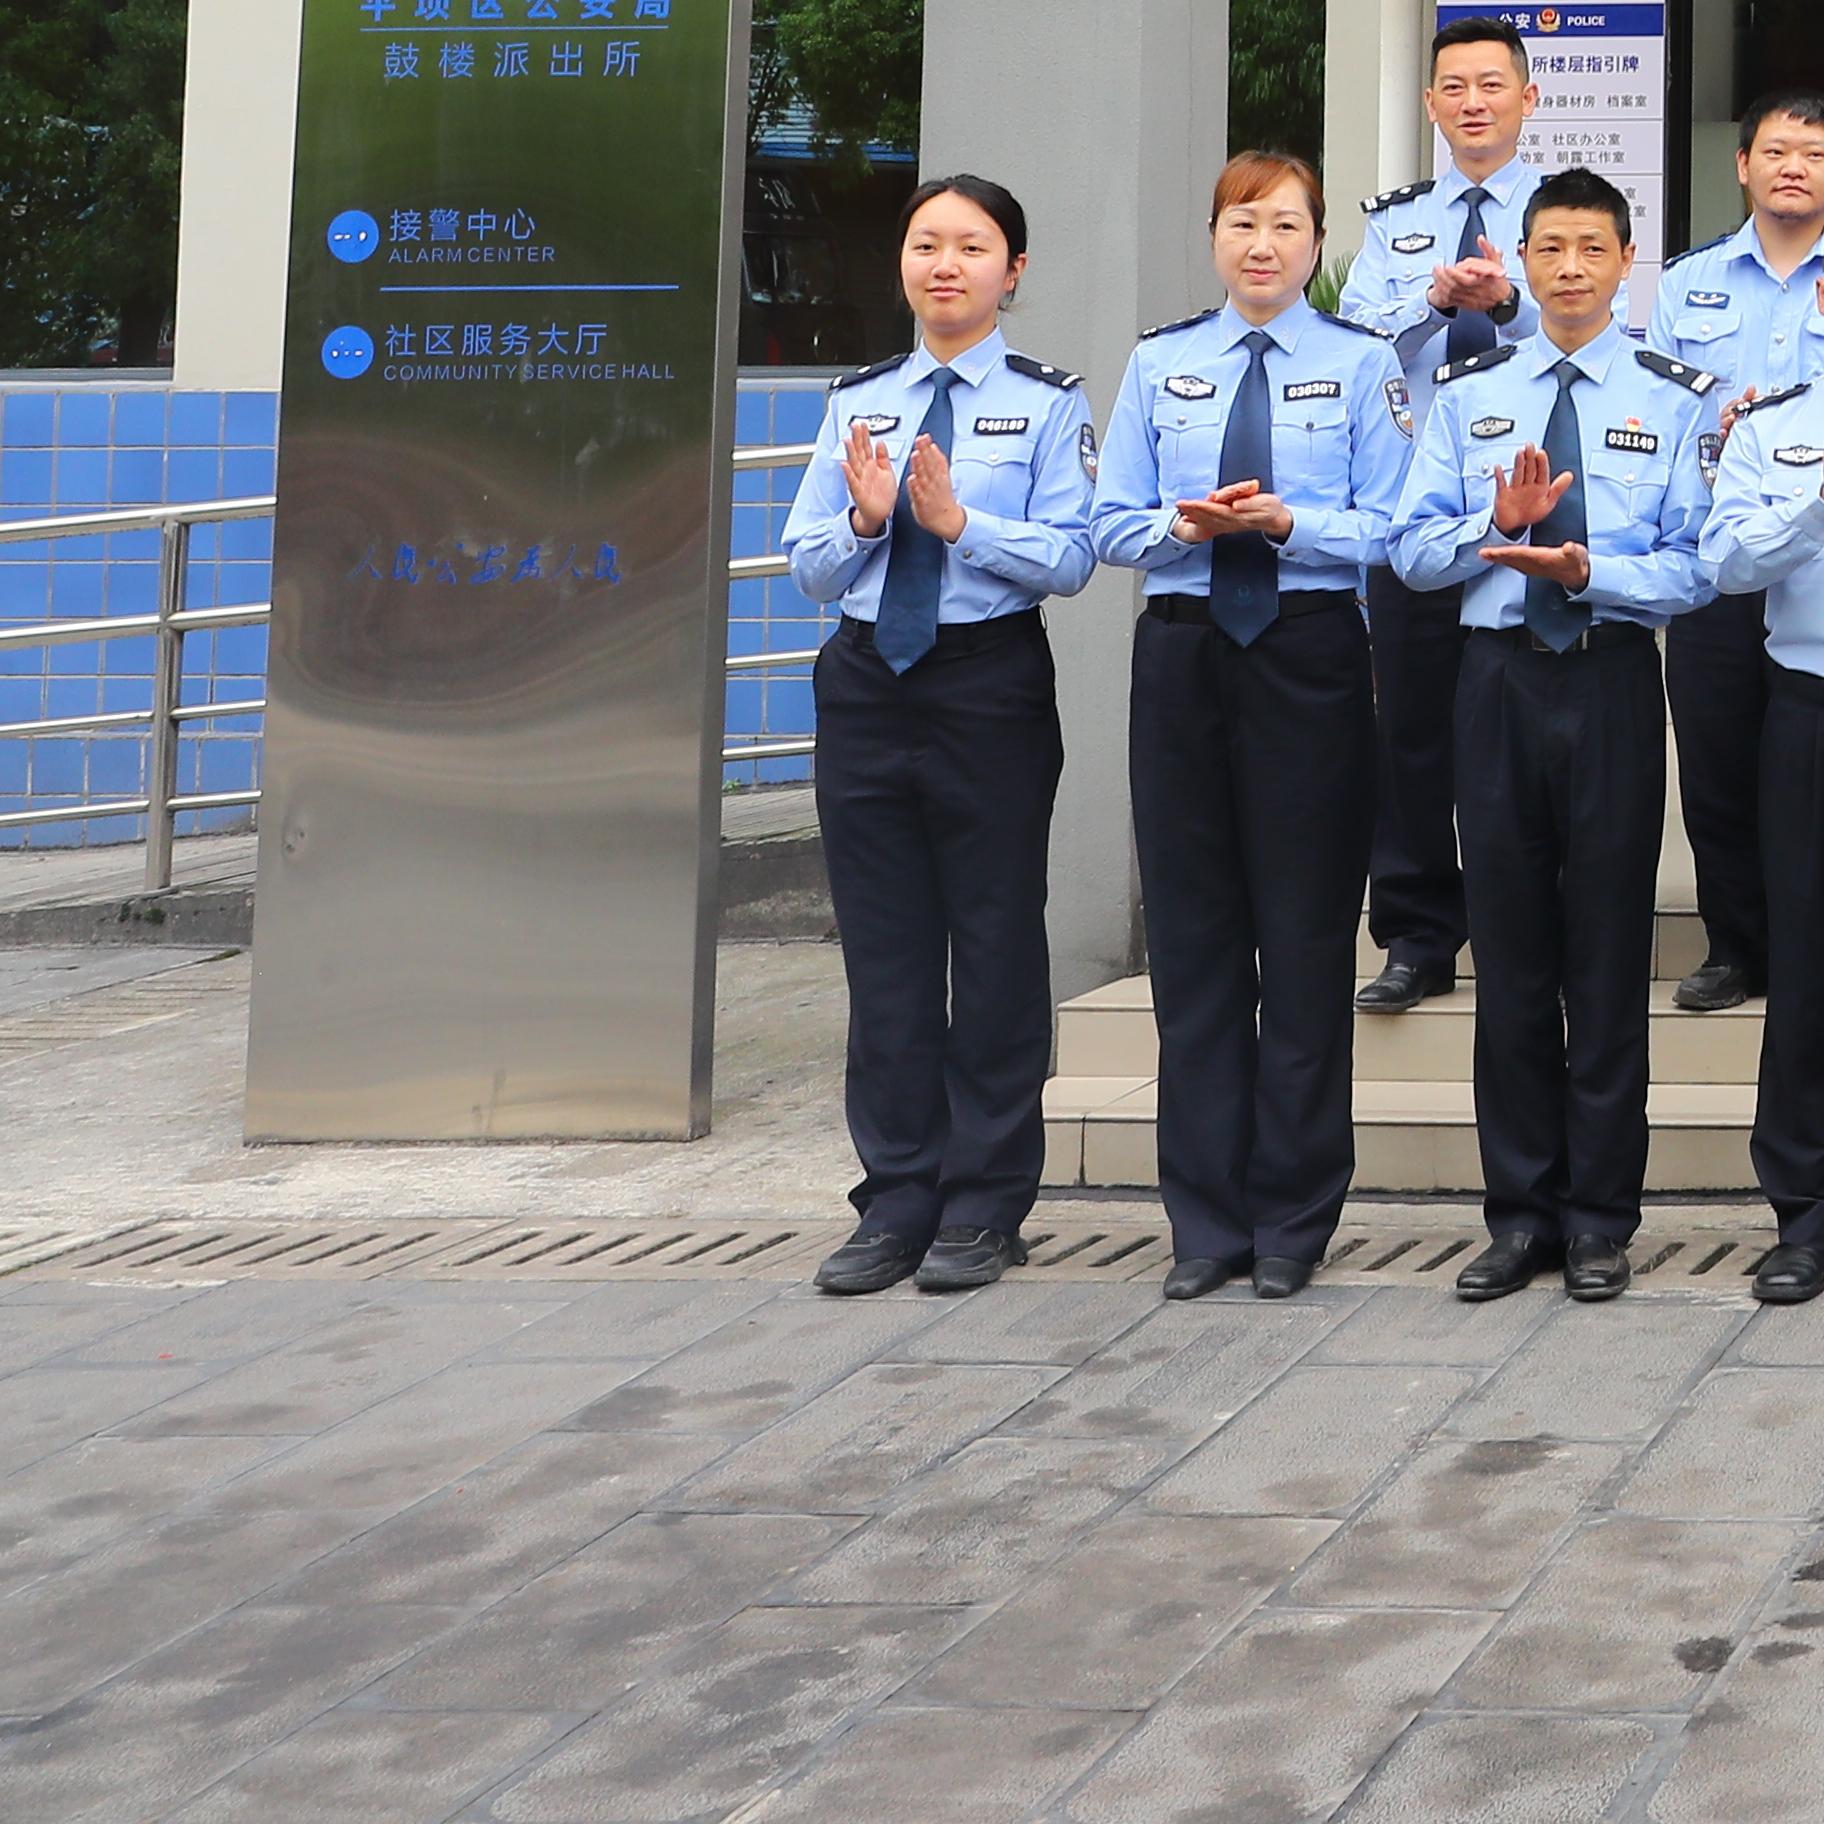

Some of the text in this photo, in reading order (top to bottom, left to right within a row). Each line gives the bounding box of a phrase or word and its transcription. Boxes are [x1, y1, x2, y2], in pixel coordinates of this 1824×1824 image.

[1567, 15, 1606, 26] POLICE
[384, 40, 641, 79] 鼓楼派出所
[1531, 55, 1640, 74] 所楼层指引牌
[1552, 133, 1621, 146] 社区办公室
[390, 208, 536, 243] 接警中心
[389, 246, 556, 263] ALARM CENTER
[384, 322, 608, 357] 社区服务大厅
[384, 362, 675, 381] COMMUNITY SERVICE HALL
